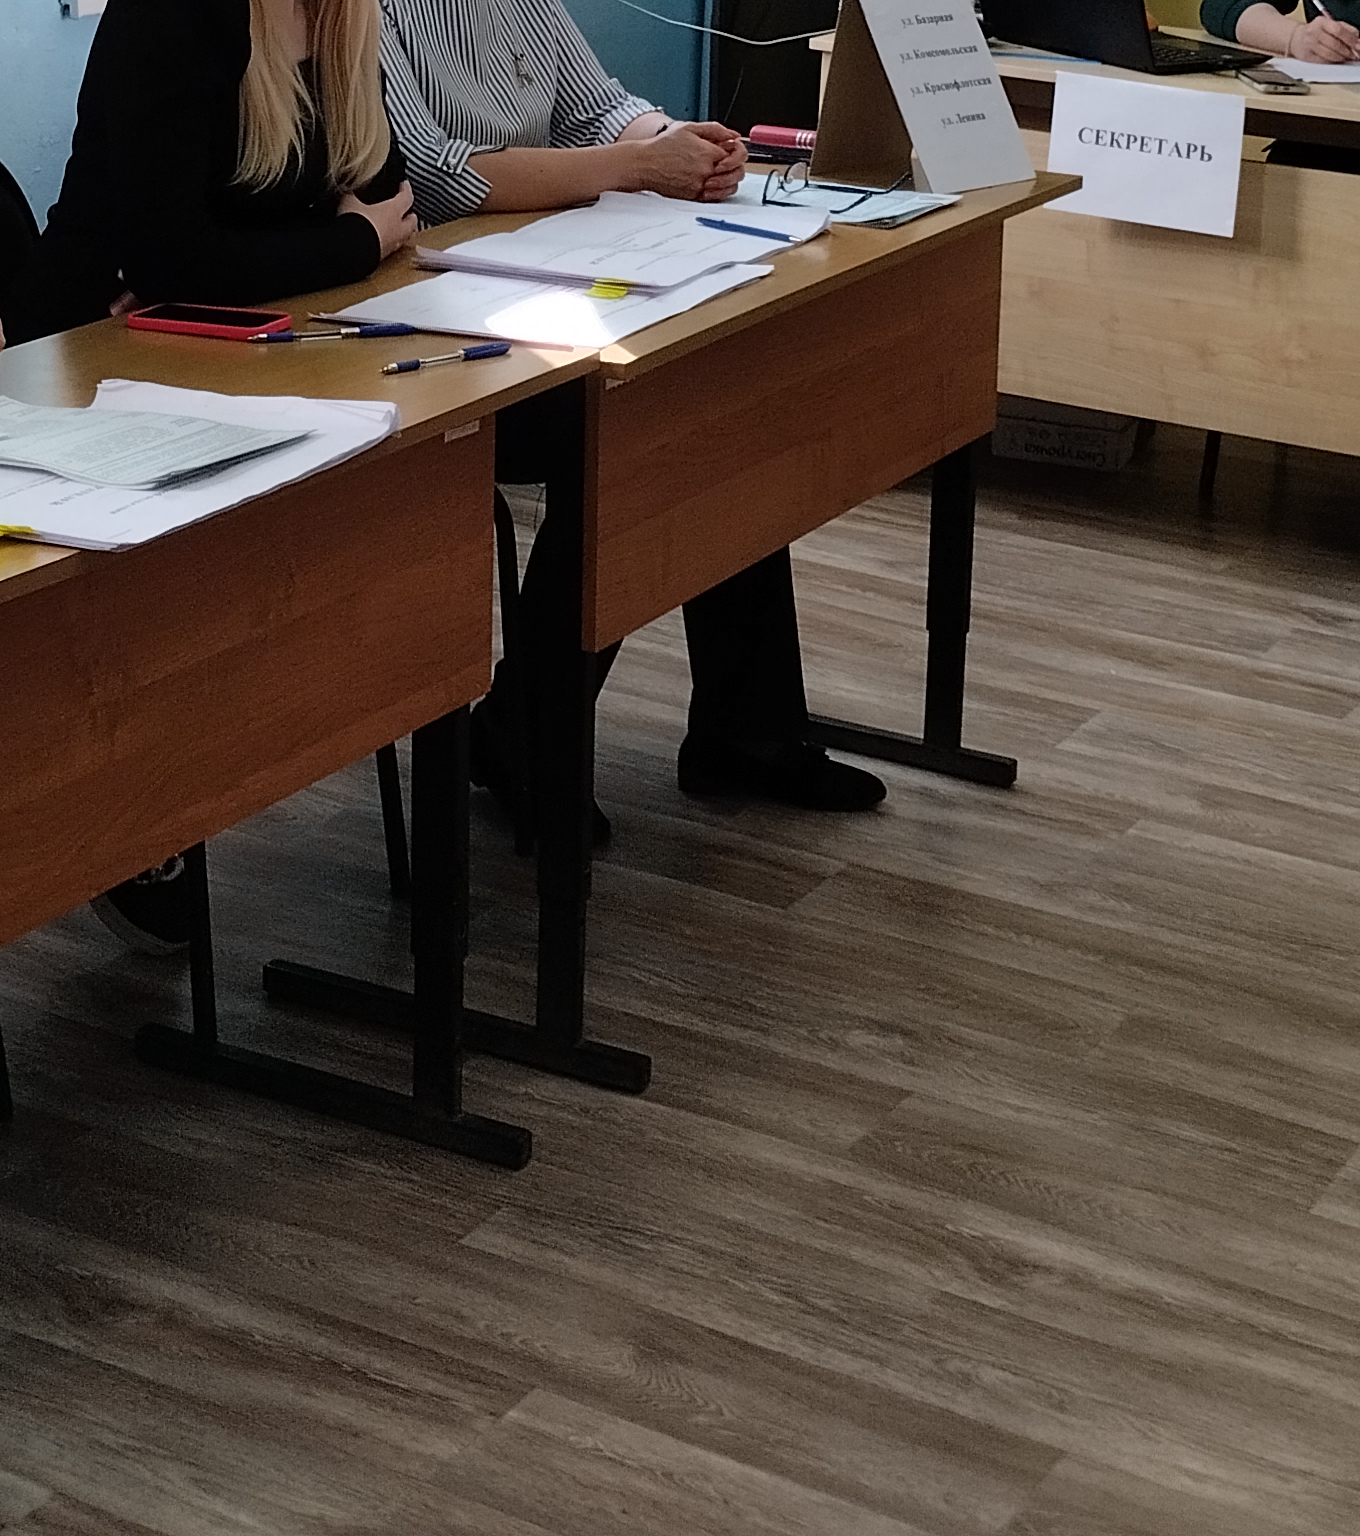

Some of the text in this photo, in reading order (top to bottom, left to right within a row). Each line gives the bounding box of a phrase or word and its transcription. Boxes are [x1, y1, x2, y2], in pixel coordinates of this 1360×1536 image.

[915, 14, 954, 26] Базарная
[913, 45, 978, 60] Комсомольская
[923, 77, 992, 95] Краснофлотская
[955, 113, 986, 125] Ленина
[1078, 127, 1213, 162] СЕКРЕТАРЬ
